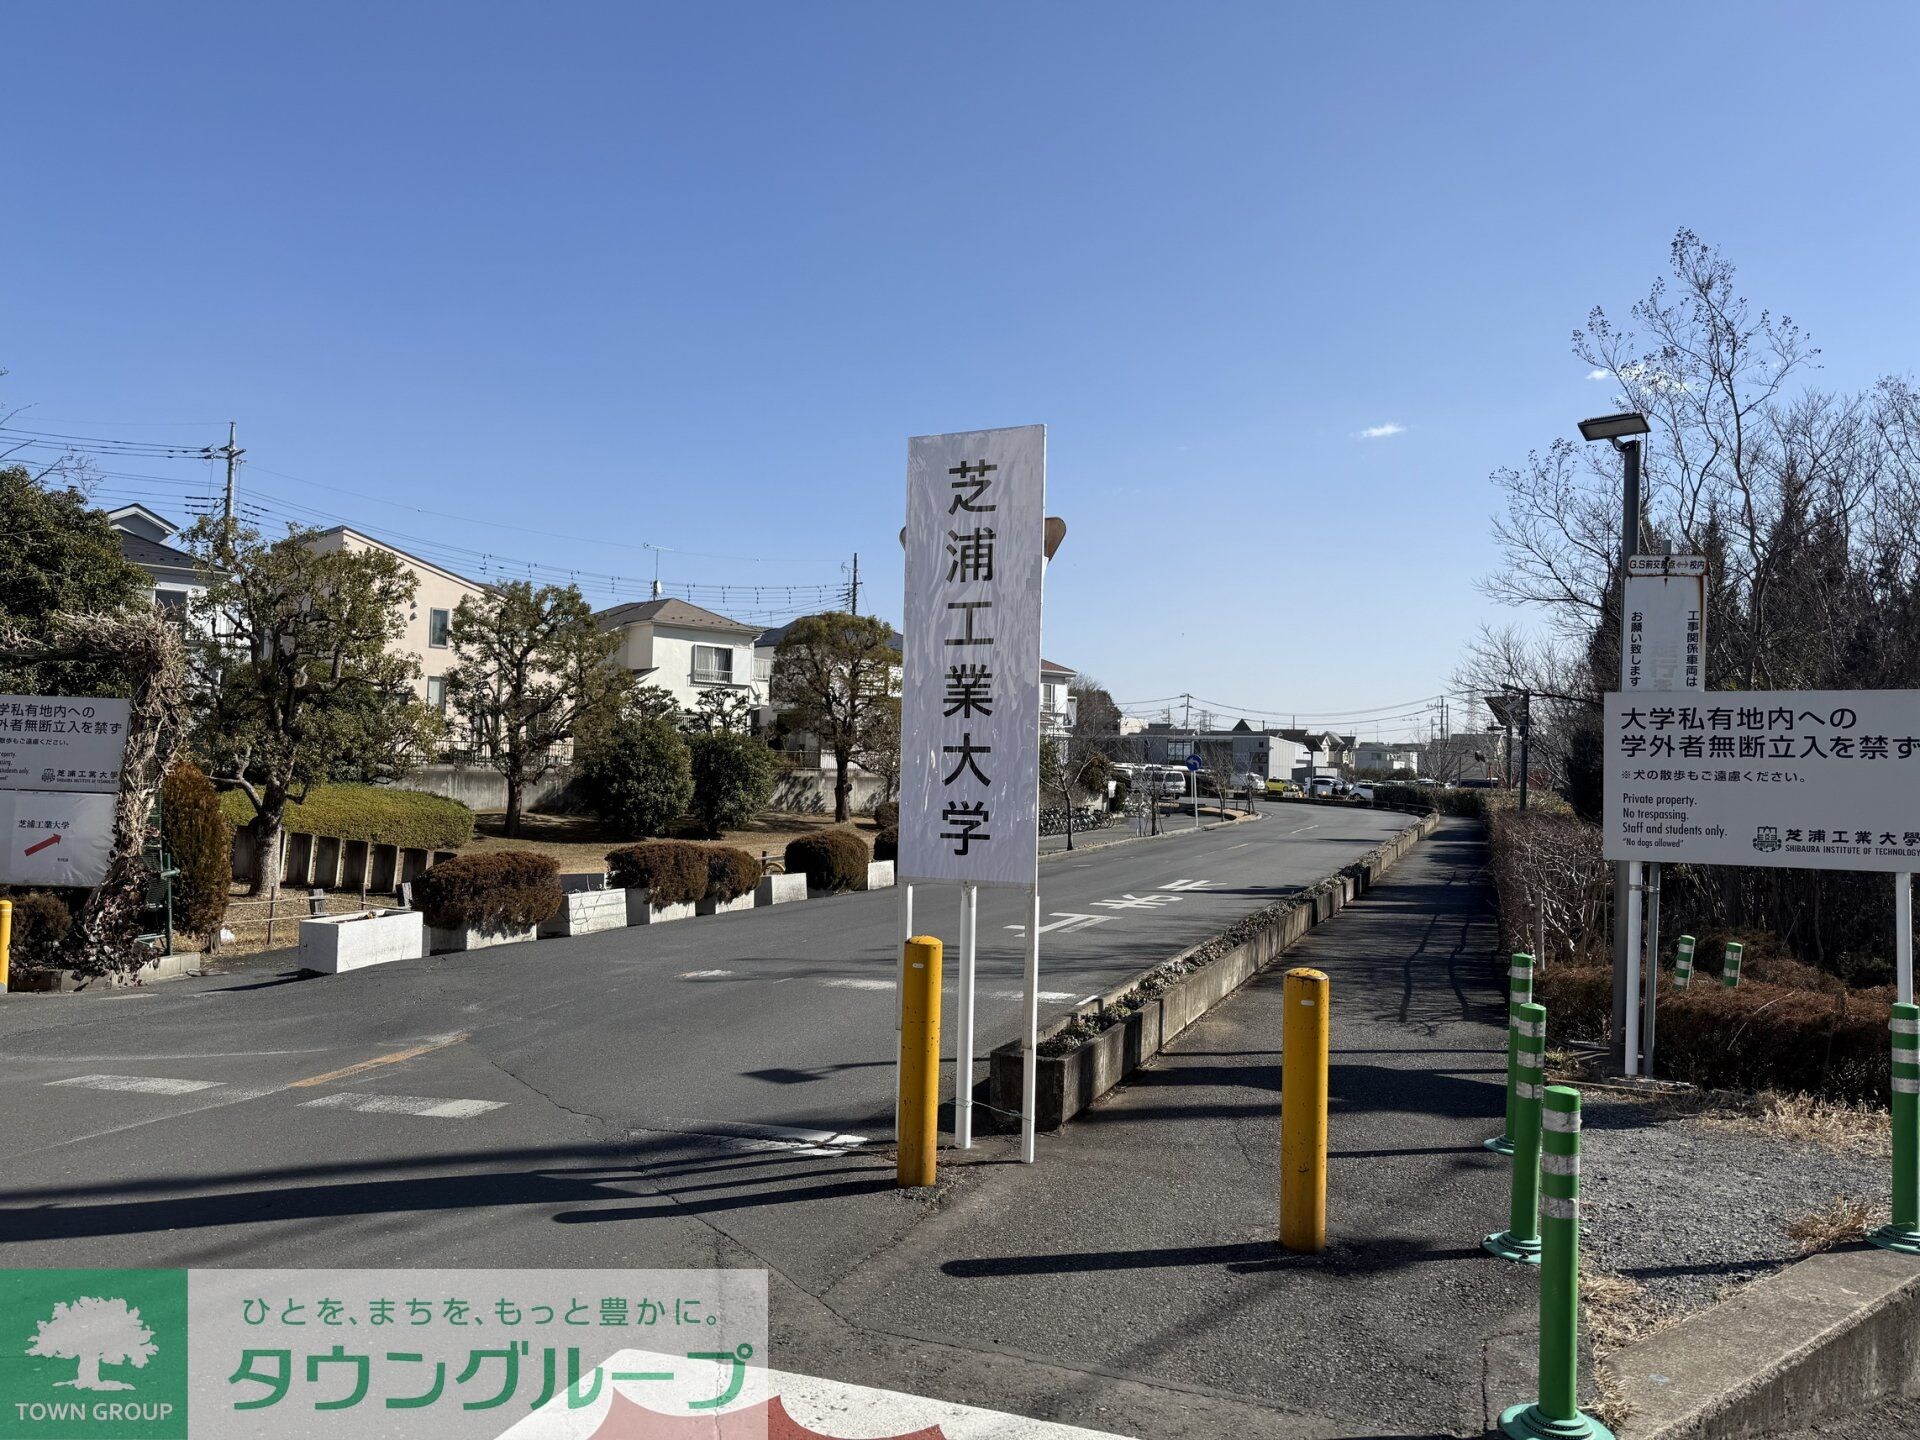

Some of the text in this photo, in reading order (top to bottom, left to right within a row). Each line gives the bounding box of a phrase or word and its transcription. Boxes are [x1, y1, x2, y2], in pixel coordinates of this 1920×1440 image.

[940, 460, 997, 856] 芝浦工業大学
[1629, 611, 1643, 687] お願い致します
[1686, 610, 1699, 687] 工事関係車両は
[1620, 706, 1857, 730] 大学私有地内への
[1620, 734, 1920, 760] 学外者無断立入を禁ず
[1623, 792, 1698, 807] Private property.
[1623, 808, 1689, 822] No trespassing.
[1622, 822, 1728, 838] Staff and students only.
[1637, 838, 1653, 848] dogs
[1786, 844, 1920, 857] SHIBAURA INSTITUTE OF TECHNOLOGY
